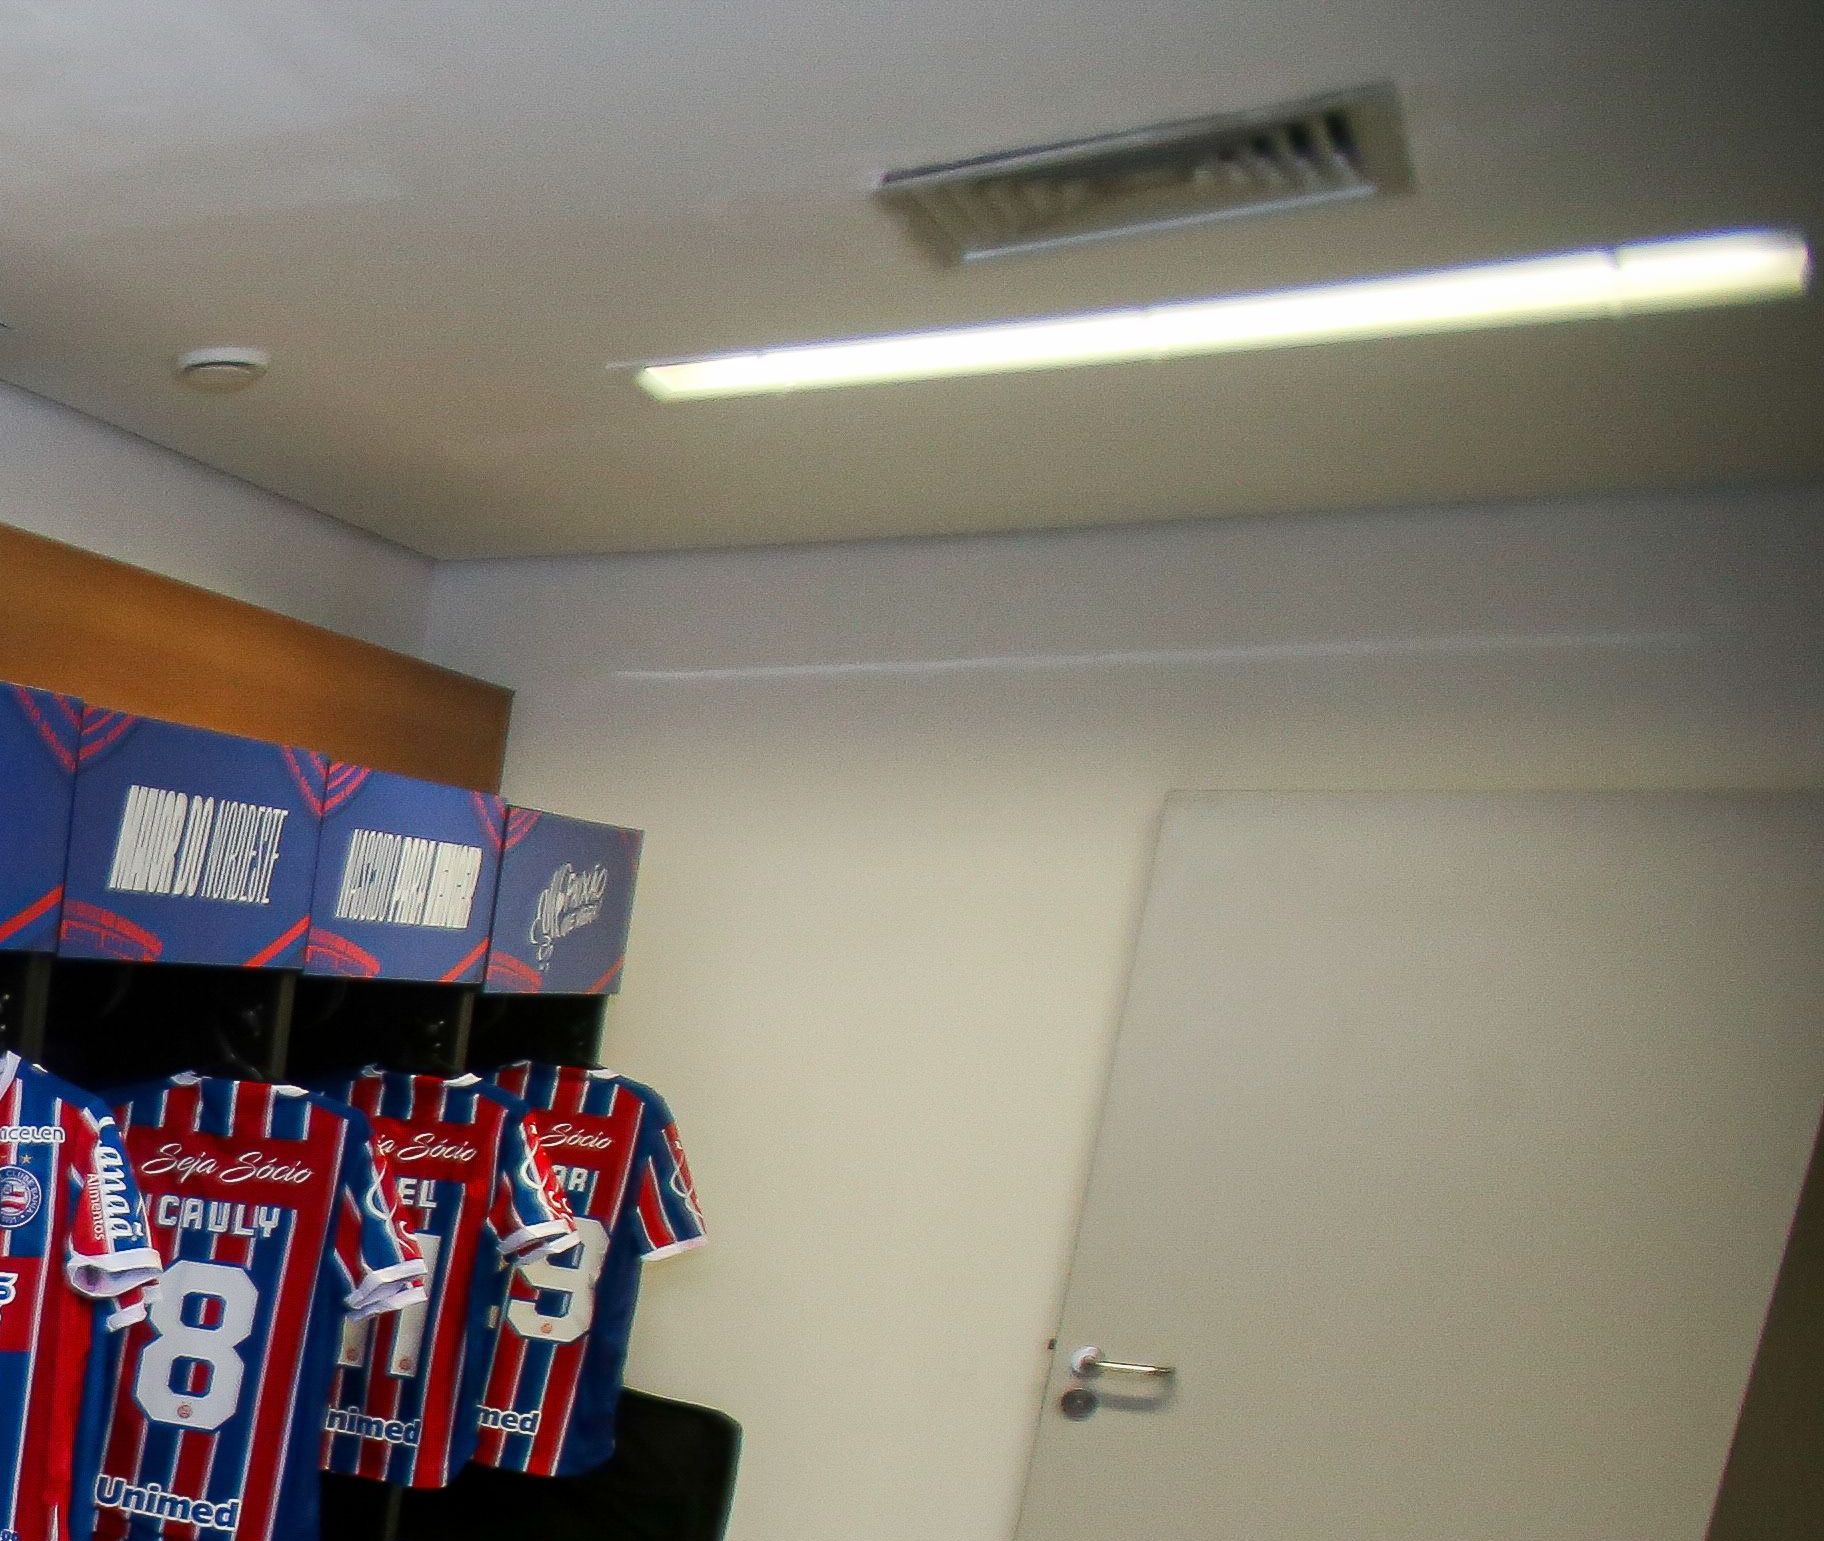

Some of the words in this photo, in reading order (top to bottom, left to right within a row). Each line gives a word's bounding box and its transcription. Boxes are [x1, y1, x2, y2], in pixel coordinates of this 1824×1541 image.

[141, 1142, 219, 1184] Seja
[219, 1151, 315, 1184] Sócio
[158, 1194, 281, 1238] CAULY
[135, 1257, 260, 1432] 8
[325, 1405, 422, 1447] nimed
[93, 1474, 242, 1532] Unimed
